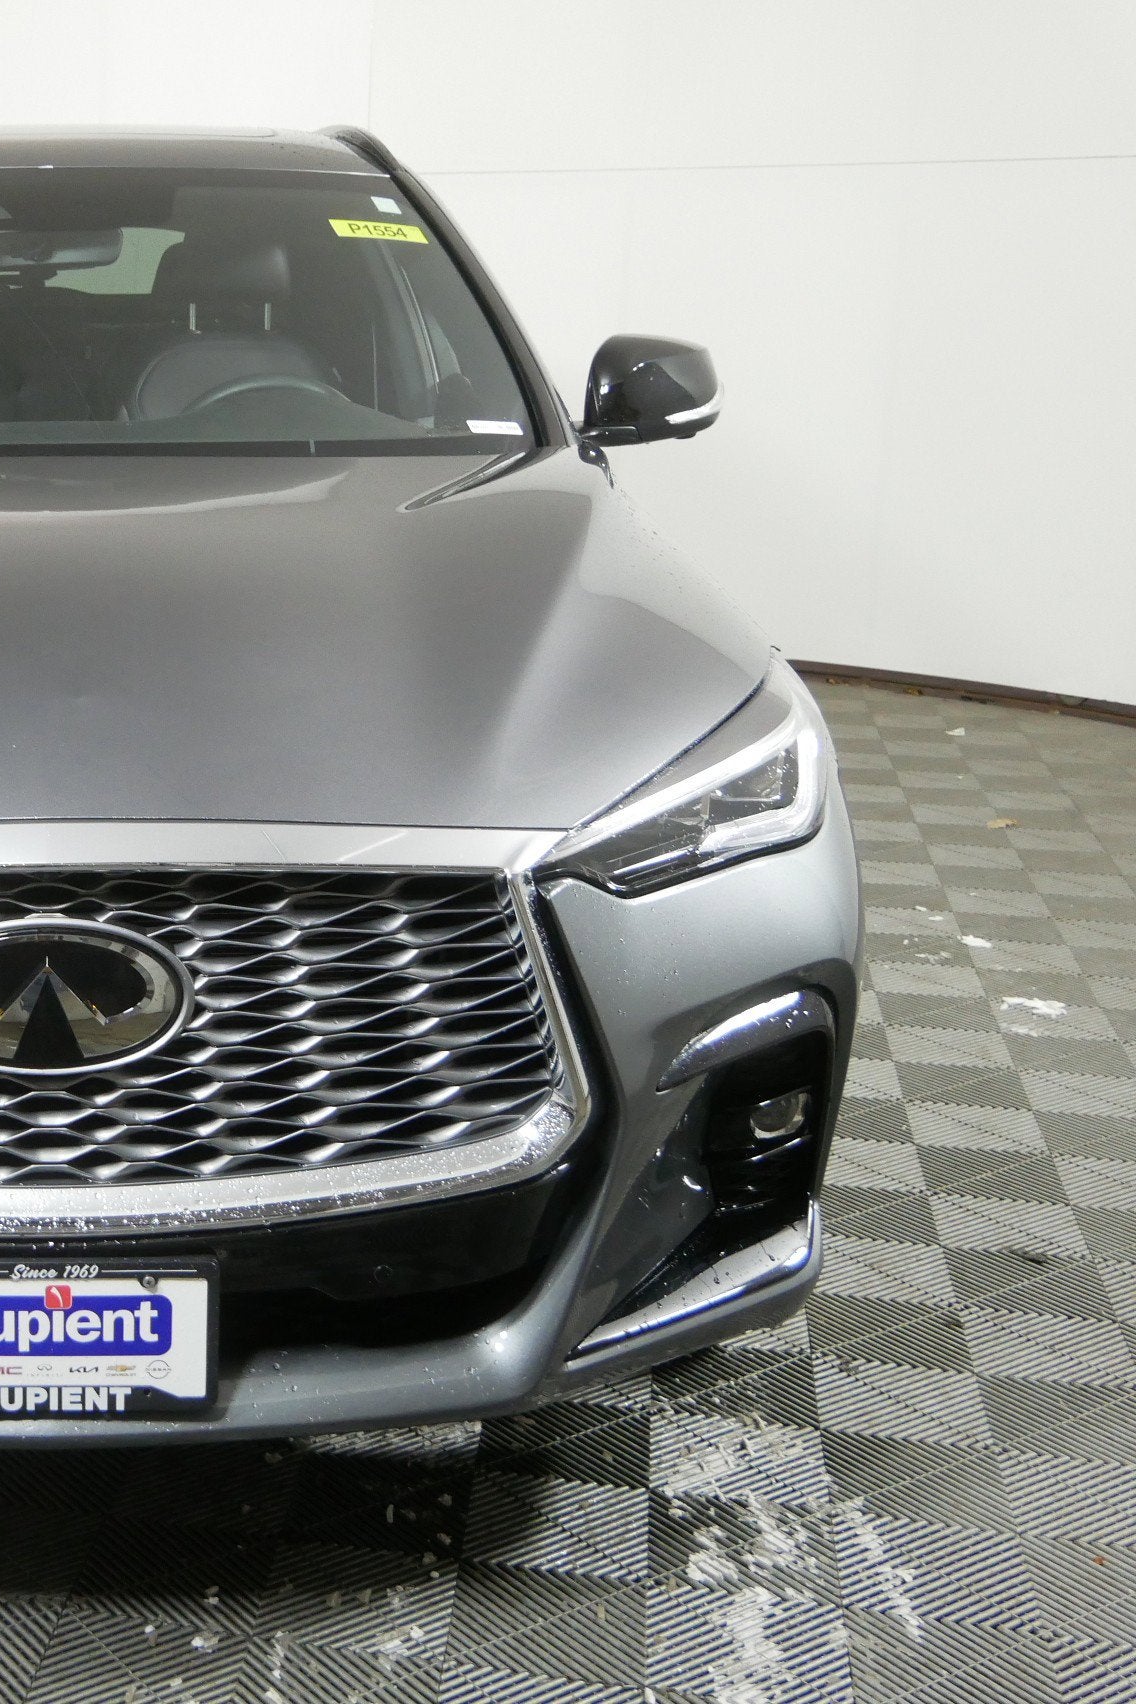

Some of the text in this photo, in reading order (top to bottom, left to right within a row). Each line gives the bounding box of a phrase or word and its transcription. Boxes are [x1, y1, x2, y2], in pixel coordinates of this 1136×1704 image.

[347, 222, 407, 239] P1554
[9, 1264, 99, 1280] Since 1969
